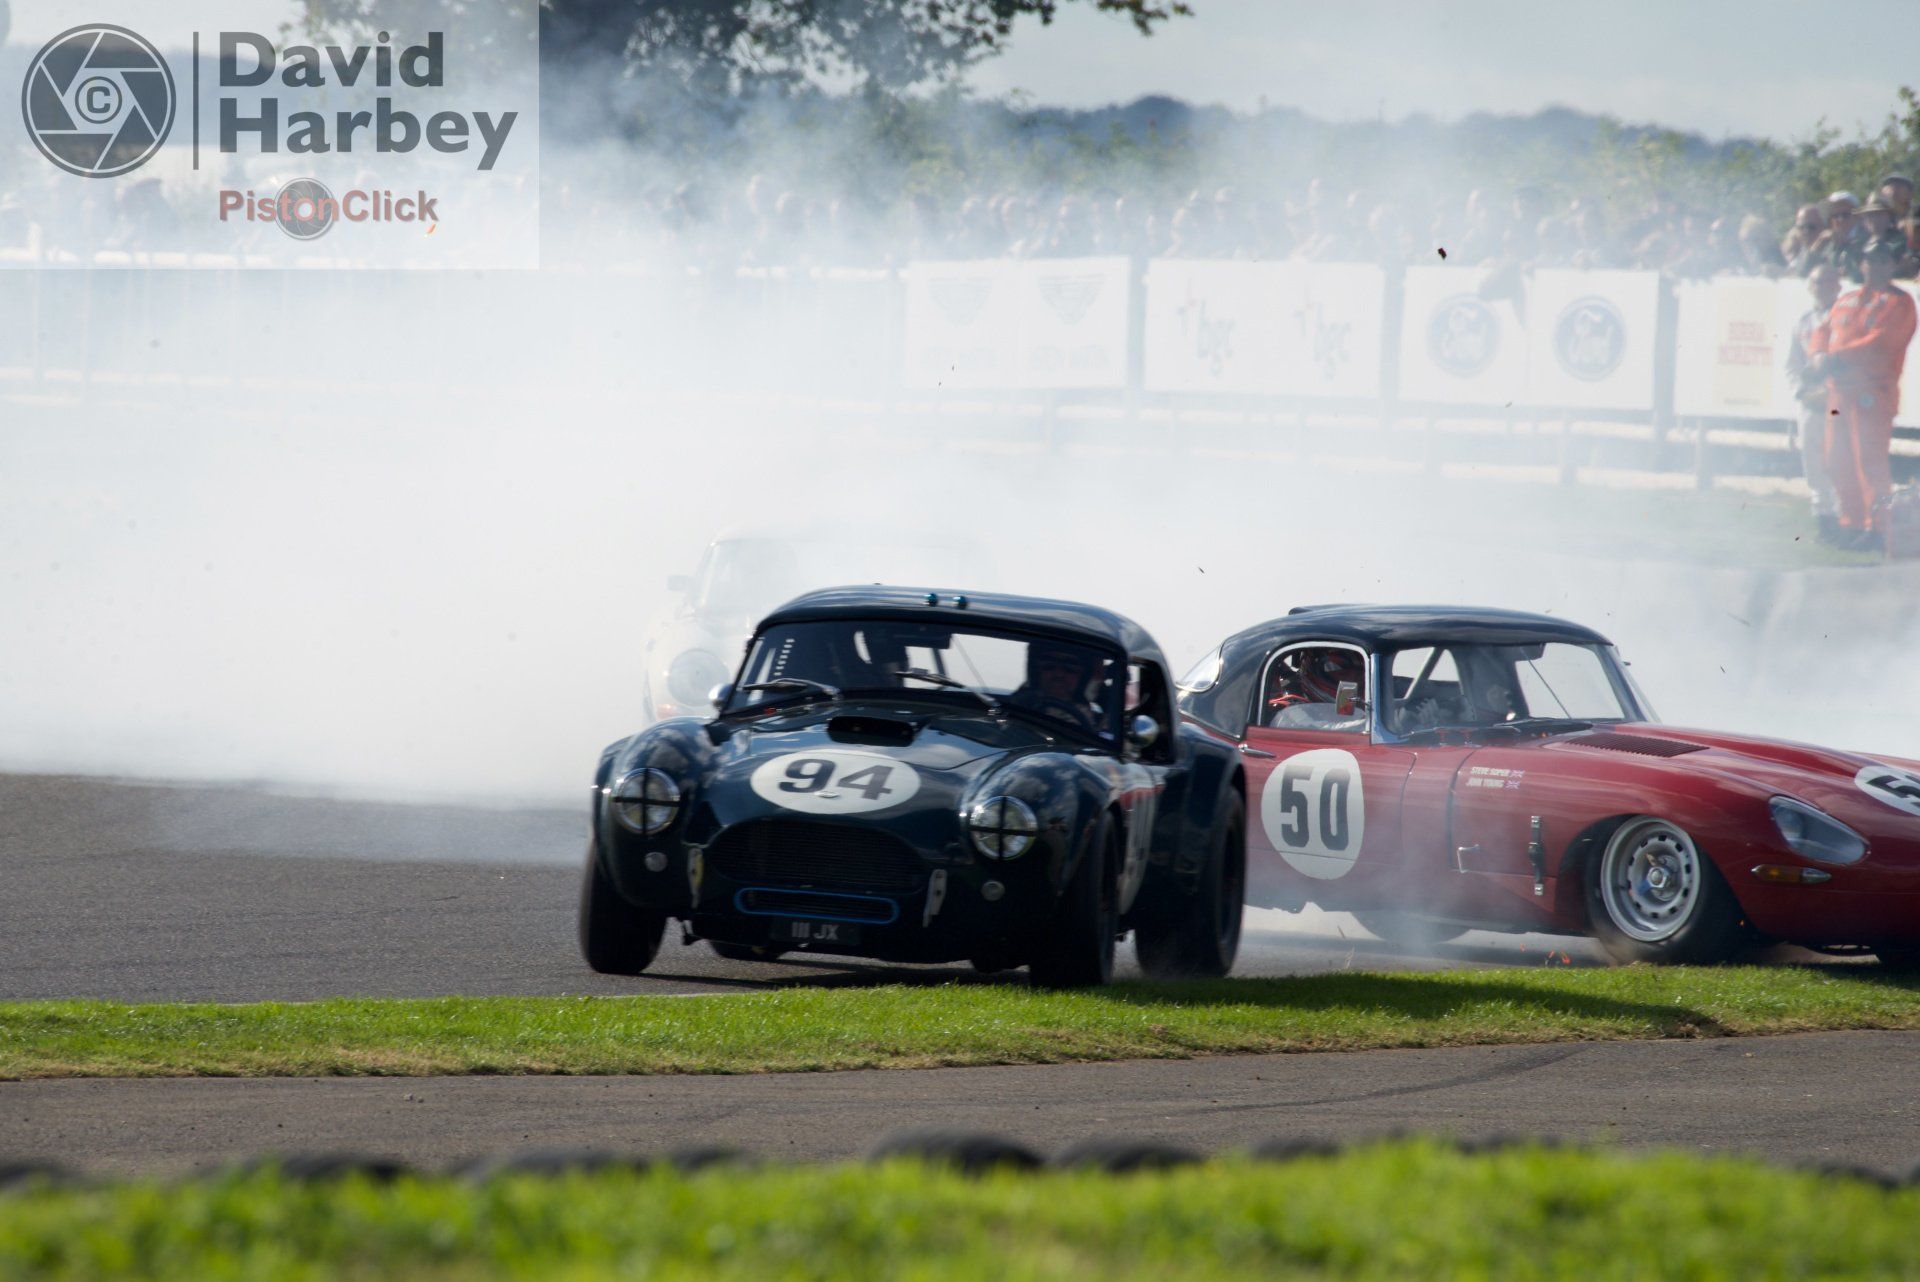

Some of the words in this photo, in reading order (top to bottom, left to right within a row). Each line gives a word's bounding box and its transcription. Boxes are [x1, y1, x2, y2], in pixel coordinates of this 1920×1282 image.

[779, 758, 895, 801] 94
[1280, 764, 1350, 850] 50
[813, 924, 840, 941] JX
